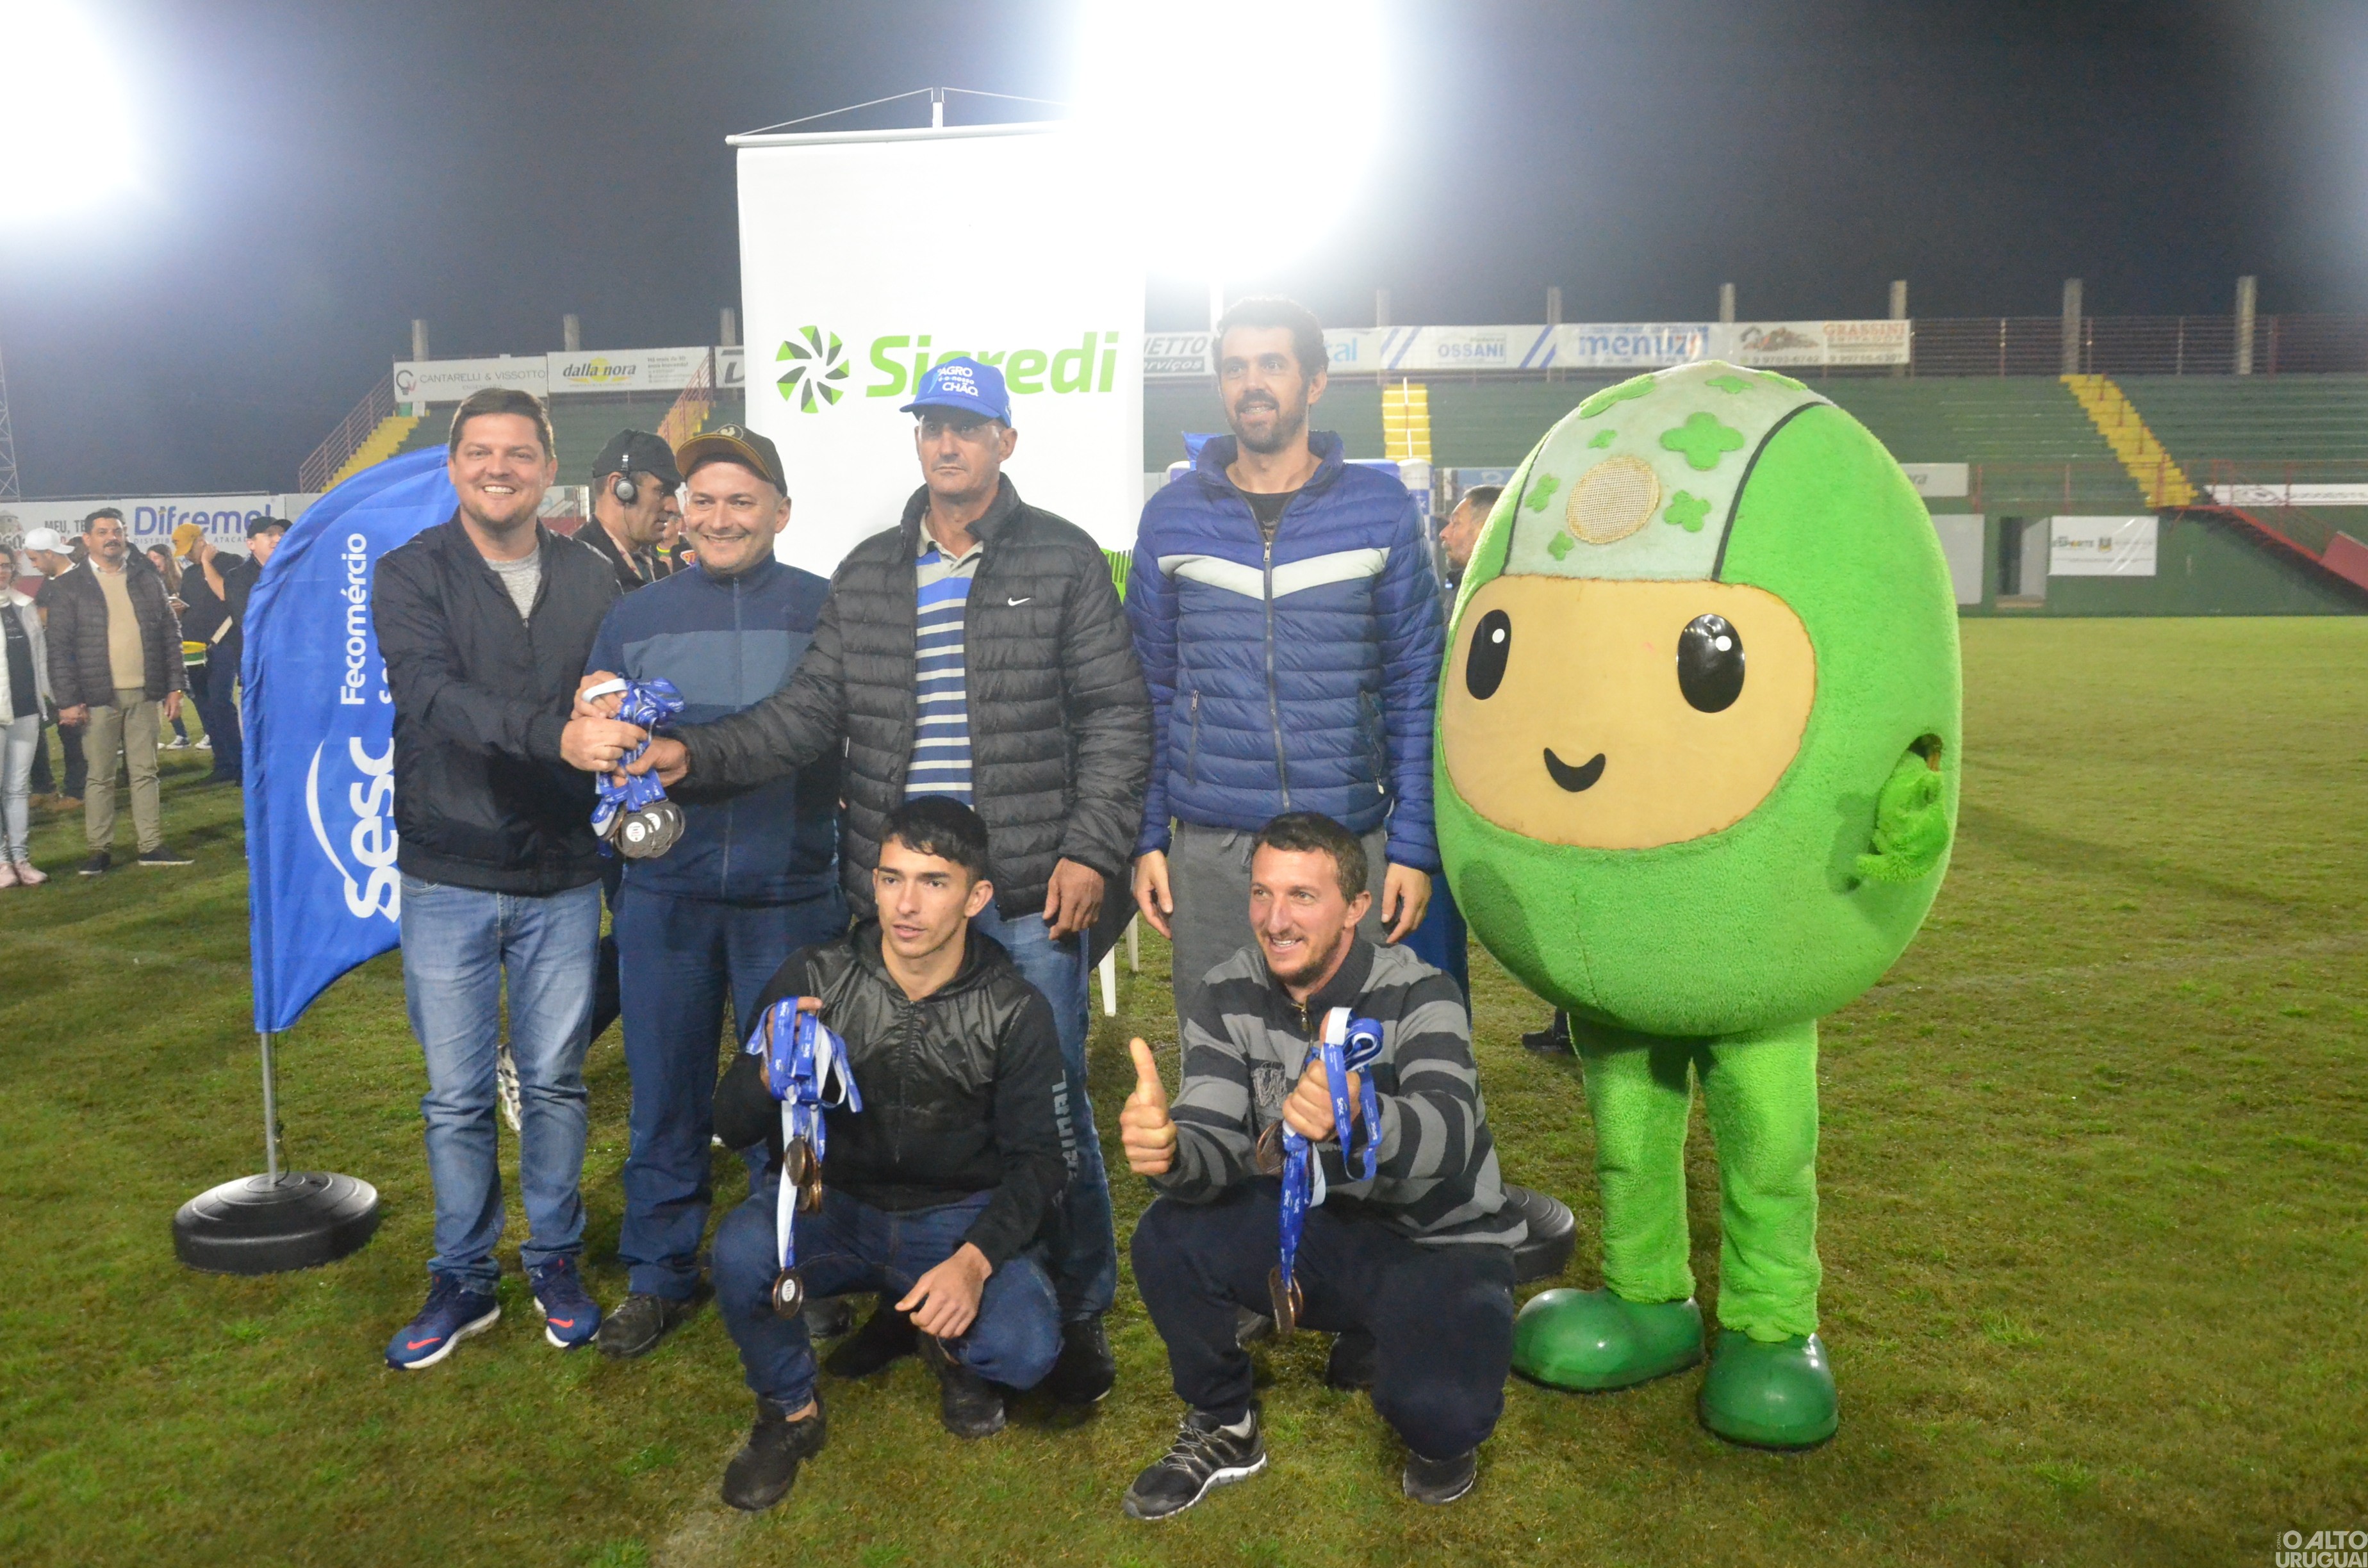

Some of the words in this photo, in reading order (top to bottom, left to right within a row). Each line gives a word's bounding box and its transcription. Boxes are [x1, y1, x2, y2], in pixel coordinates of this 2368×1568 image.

[1438, 343, 1504, 357] OSSANI
[563, 363, 598, 377] dalla
[602, 363, 637, 376] nora
[866, 331, 1119, 397] Siredi
[420, 373, 481, 384] CANTARELLI
[494, 370, 546, 380] VISSOTTO
[939, 366, 973, 377] AGRO
[952, 376, 975, 385] nosso
[340, 532, 367, 705] Fecomércio
